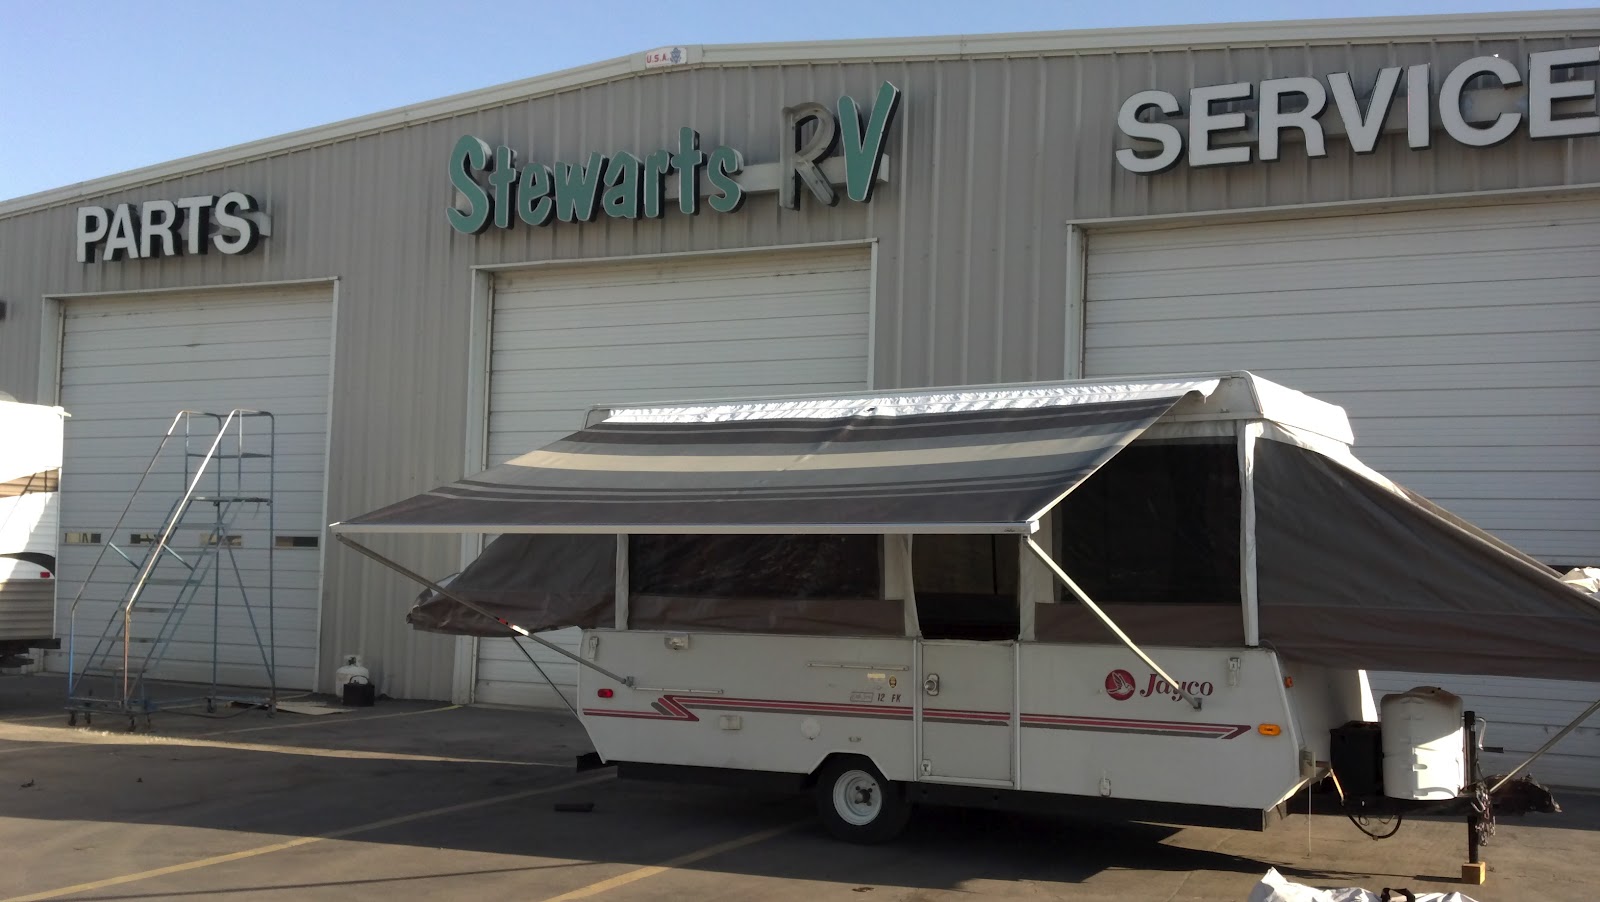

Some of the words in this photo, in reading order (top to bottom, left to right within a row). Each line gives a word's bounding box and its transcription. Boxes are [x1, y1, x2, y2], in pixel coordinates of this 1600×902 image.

[447, 127, 744, 235] Stewarts
[780, 81, 900, 210] RV
[1115, 46, 1600, 174] SERVICE
[77, 191, 260, 263] PARTS
